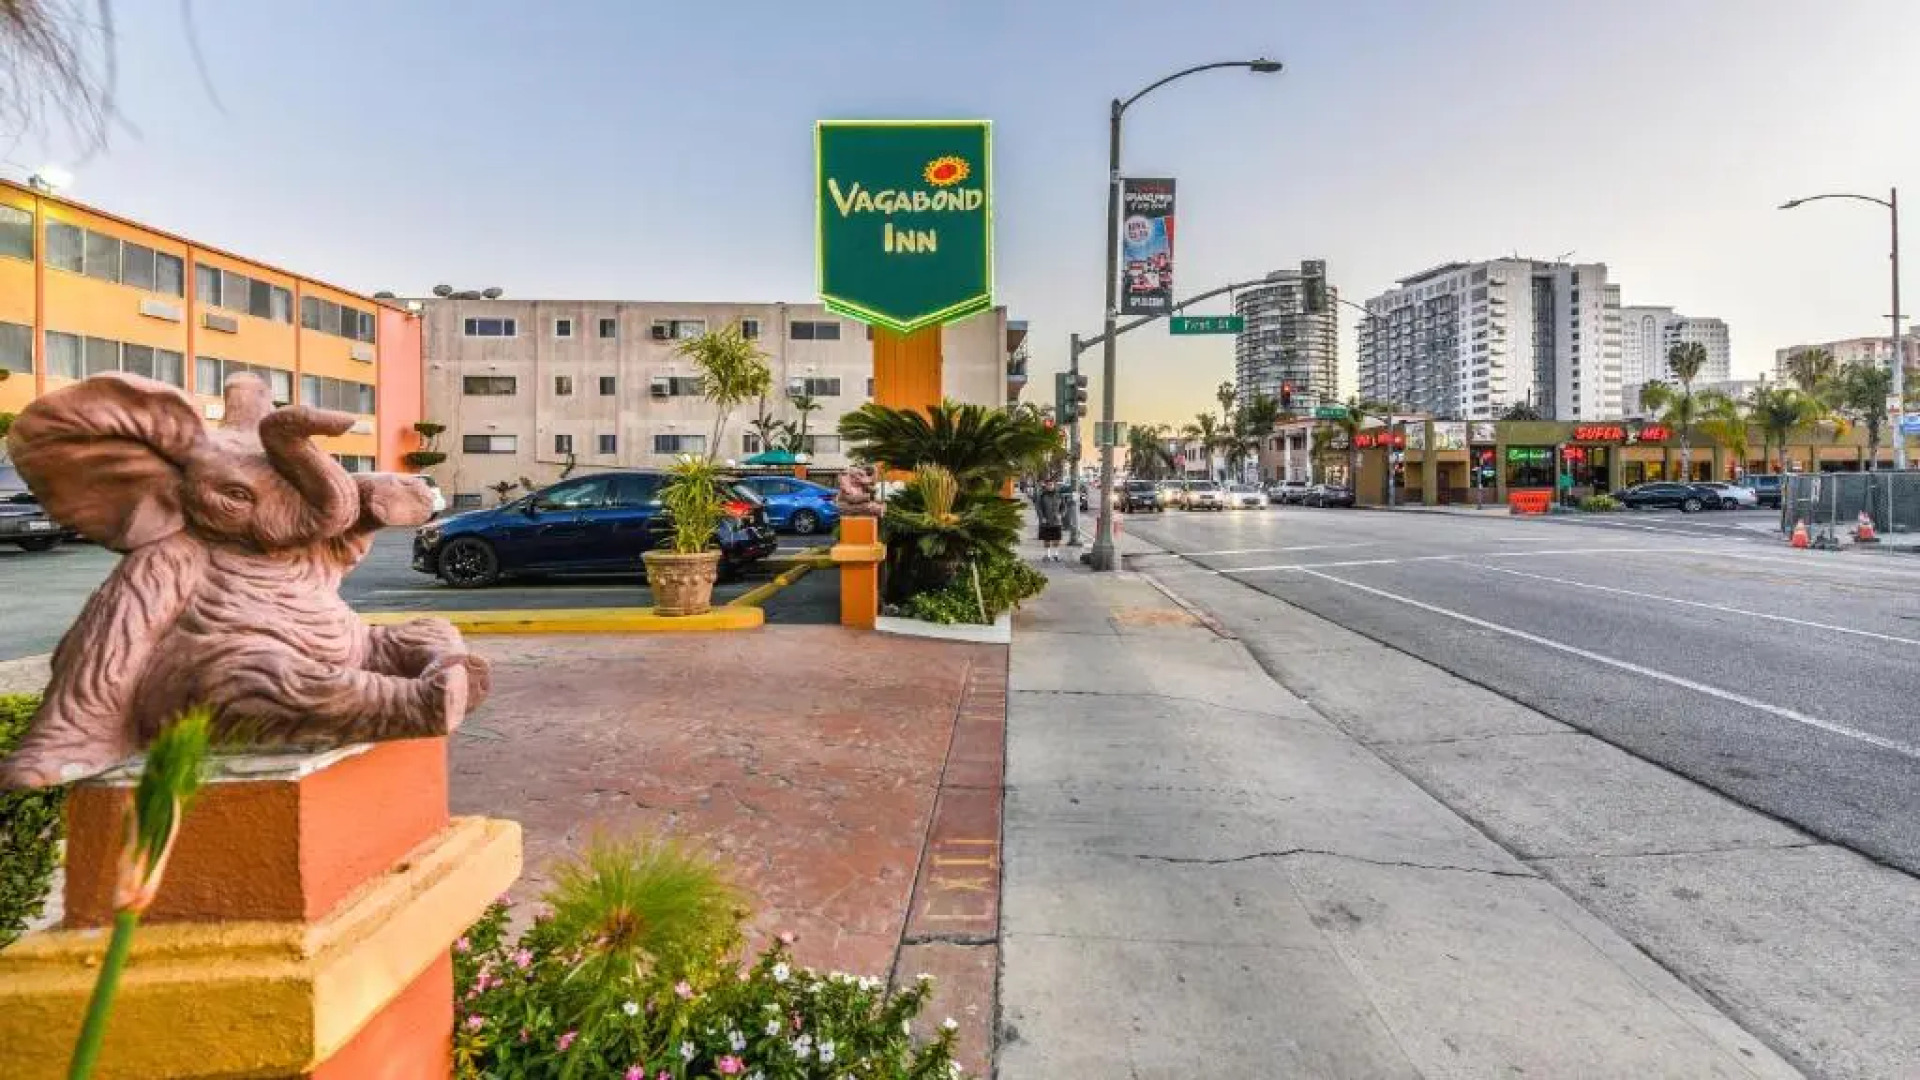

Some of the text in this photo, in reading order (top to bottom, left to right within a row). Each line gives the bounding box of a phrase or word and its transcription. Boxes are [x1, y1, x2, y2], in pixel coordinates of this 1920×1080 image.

[827, 177, 983, 218] VAGABOND
[884, 222, 937, 254] INN
[1575, 426, 1622, 440] SUPER
